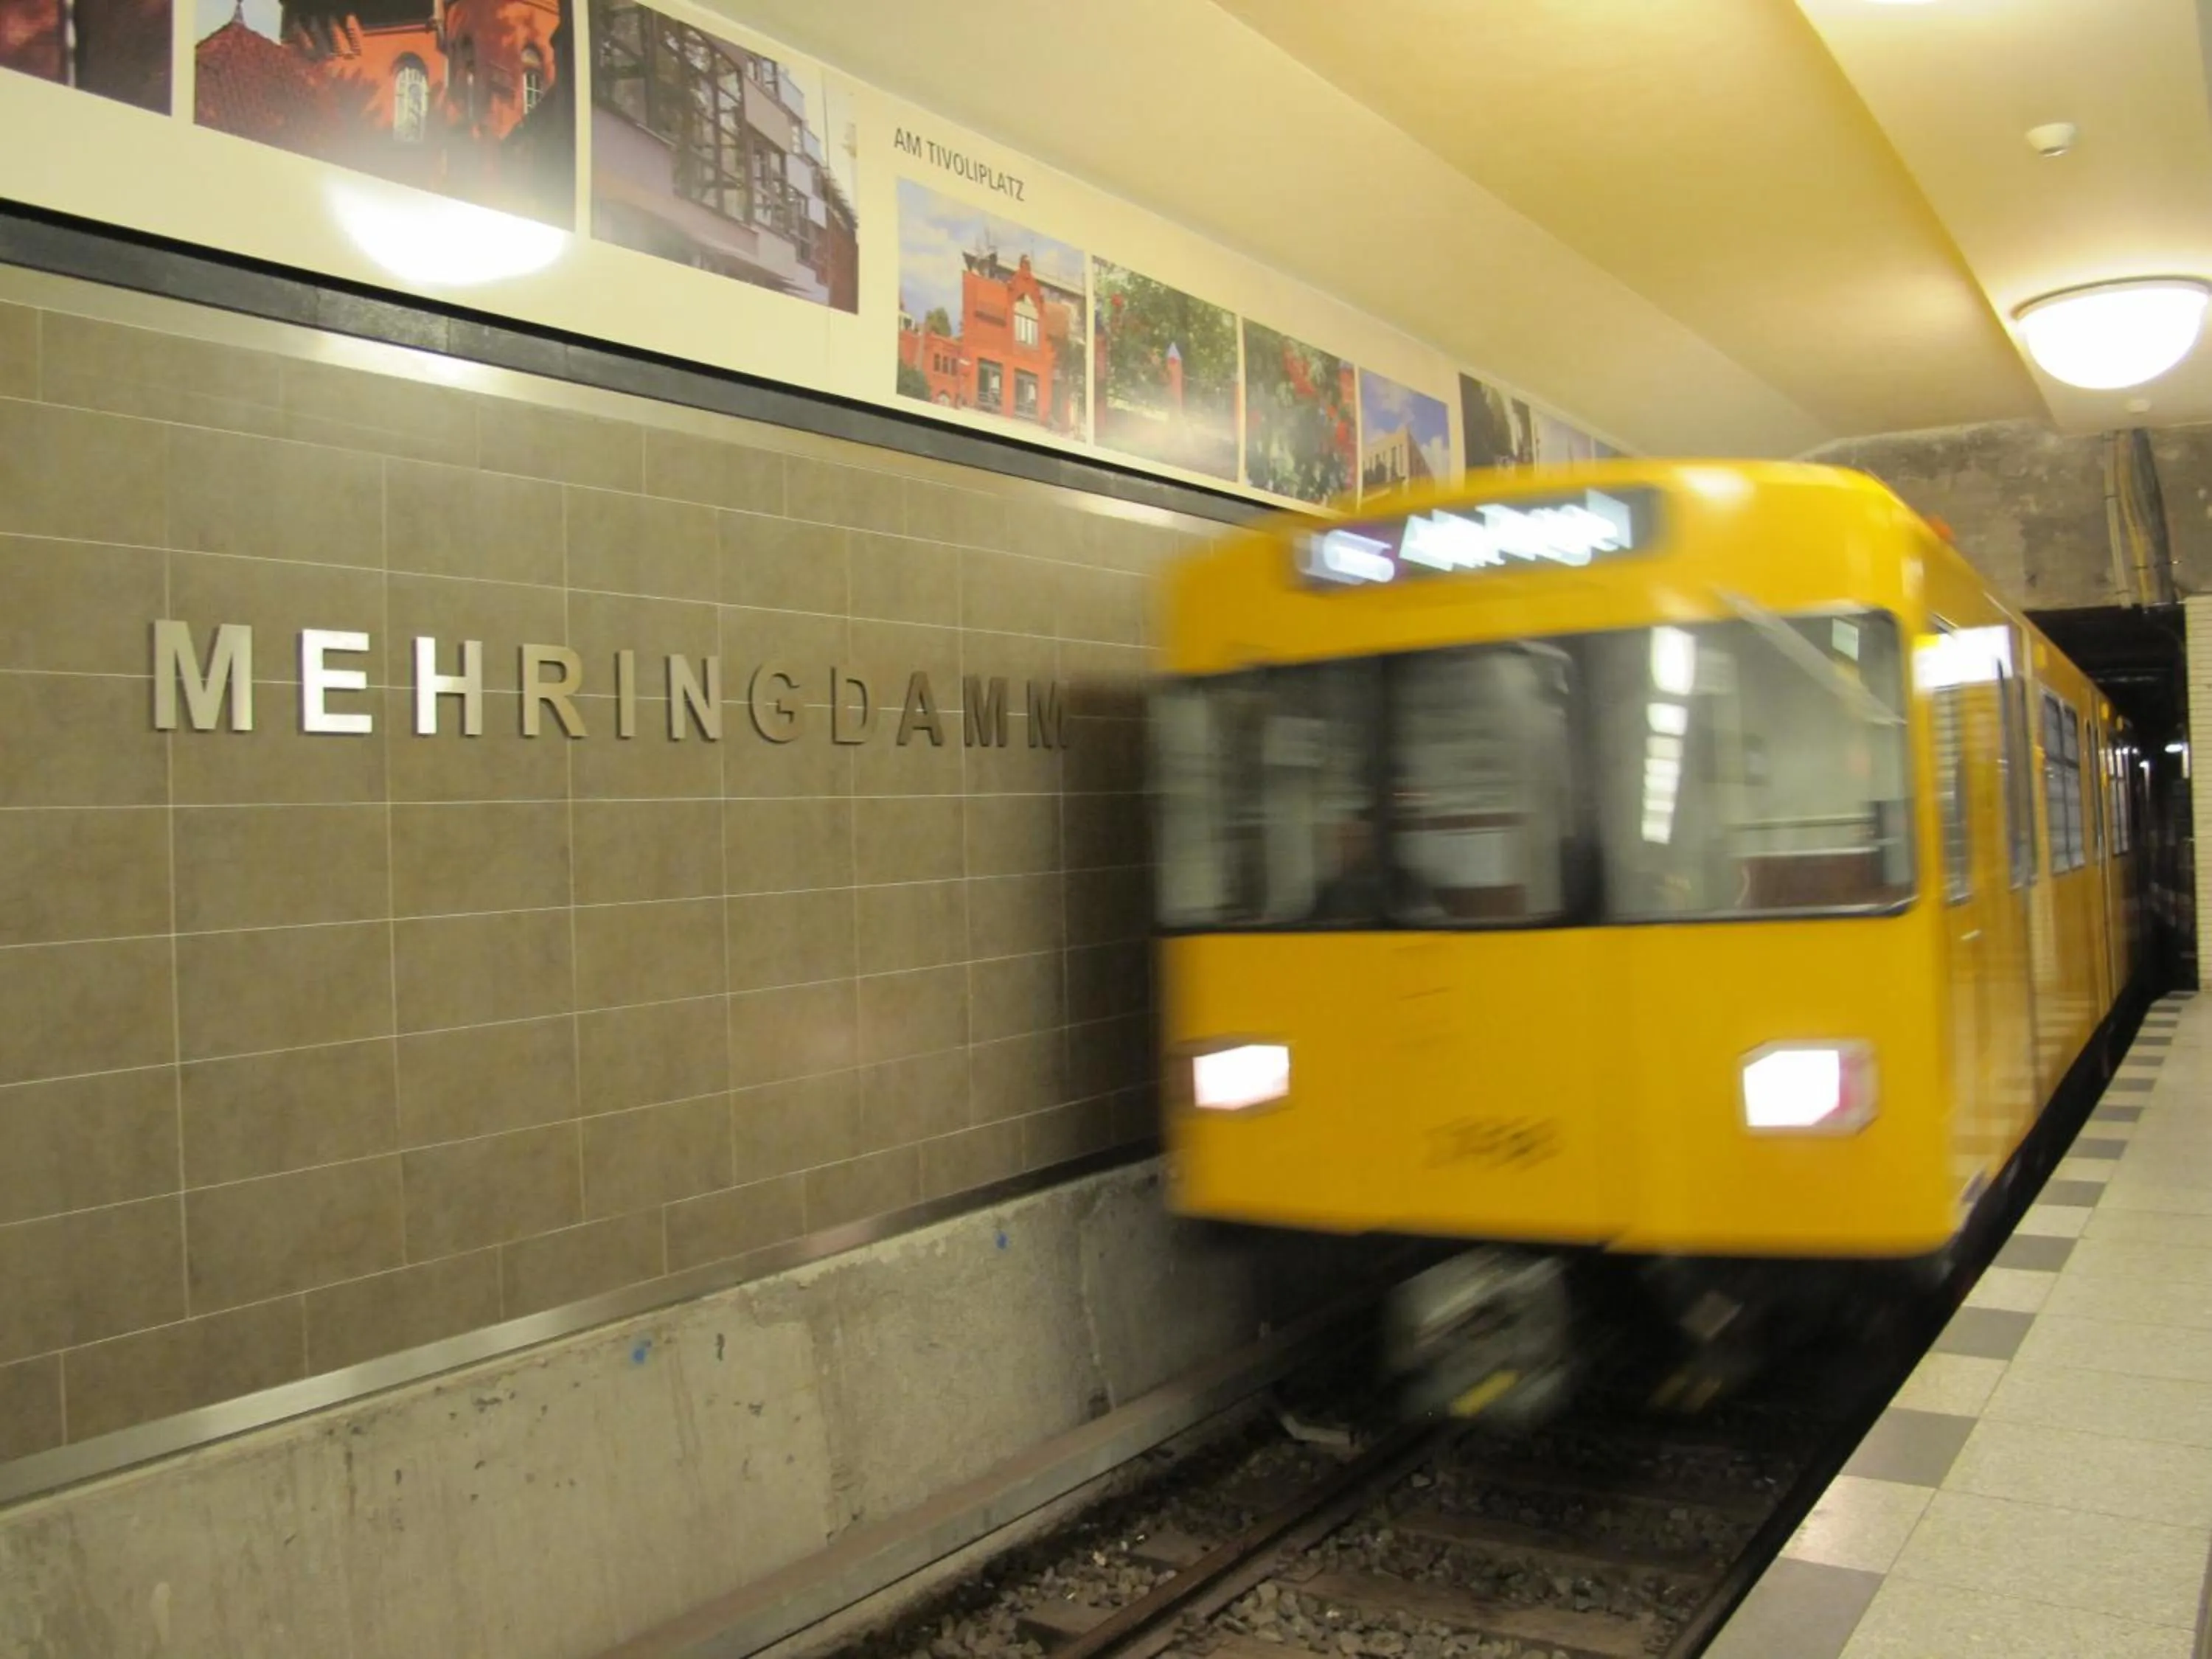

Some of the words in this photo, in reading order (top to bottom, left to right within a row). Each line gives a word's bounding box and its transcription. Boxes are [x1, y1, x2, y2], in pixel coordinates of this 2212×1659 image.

[894, 127, 922, 159] AM
[926, 140, 1025, 201] TIVOLIPLATZ
[153, 619, 1068, 749] MEHRINGDAMM
